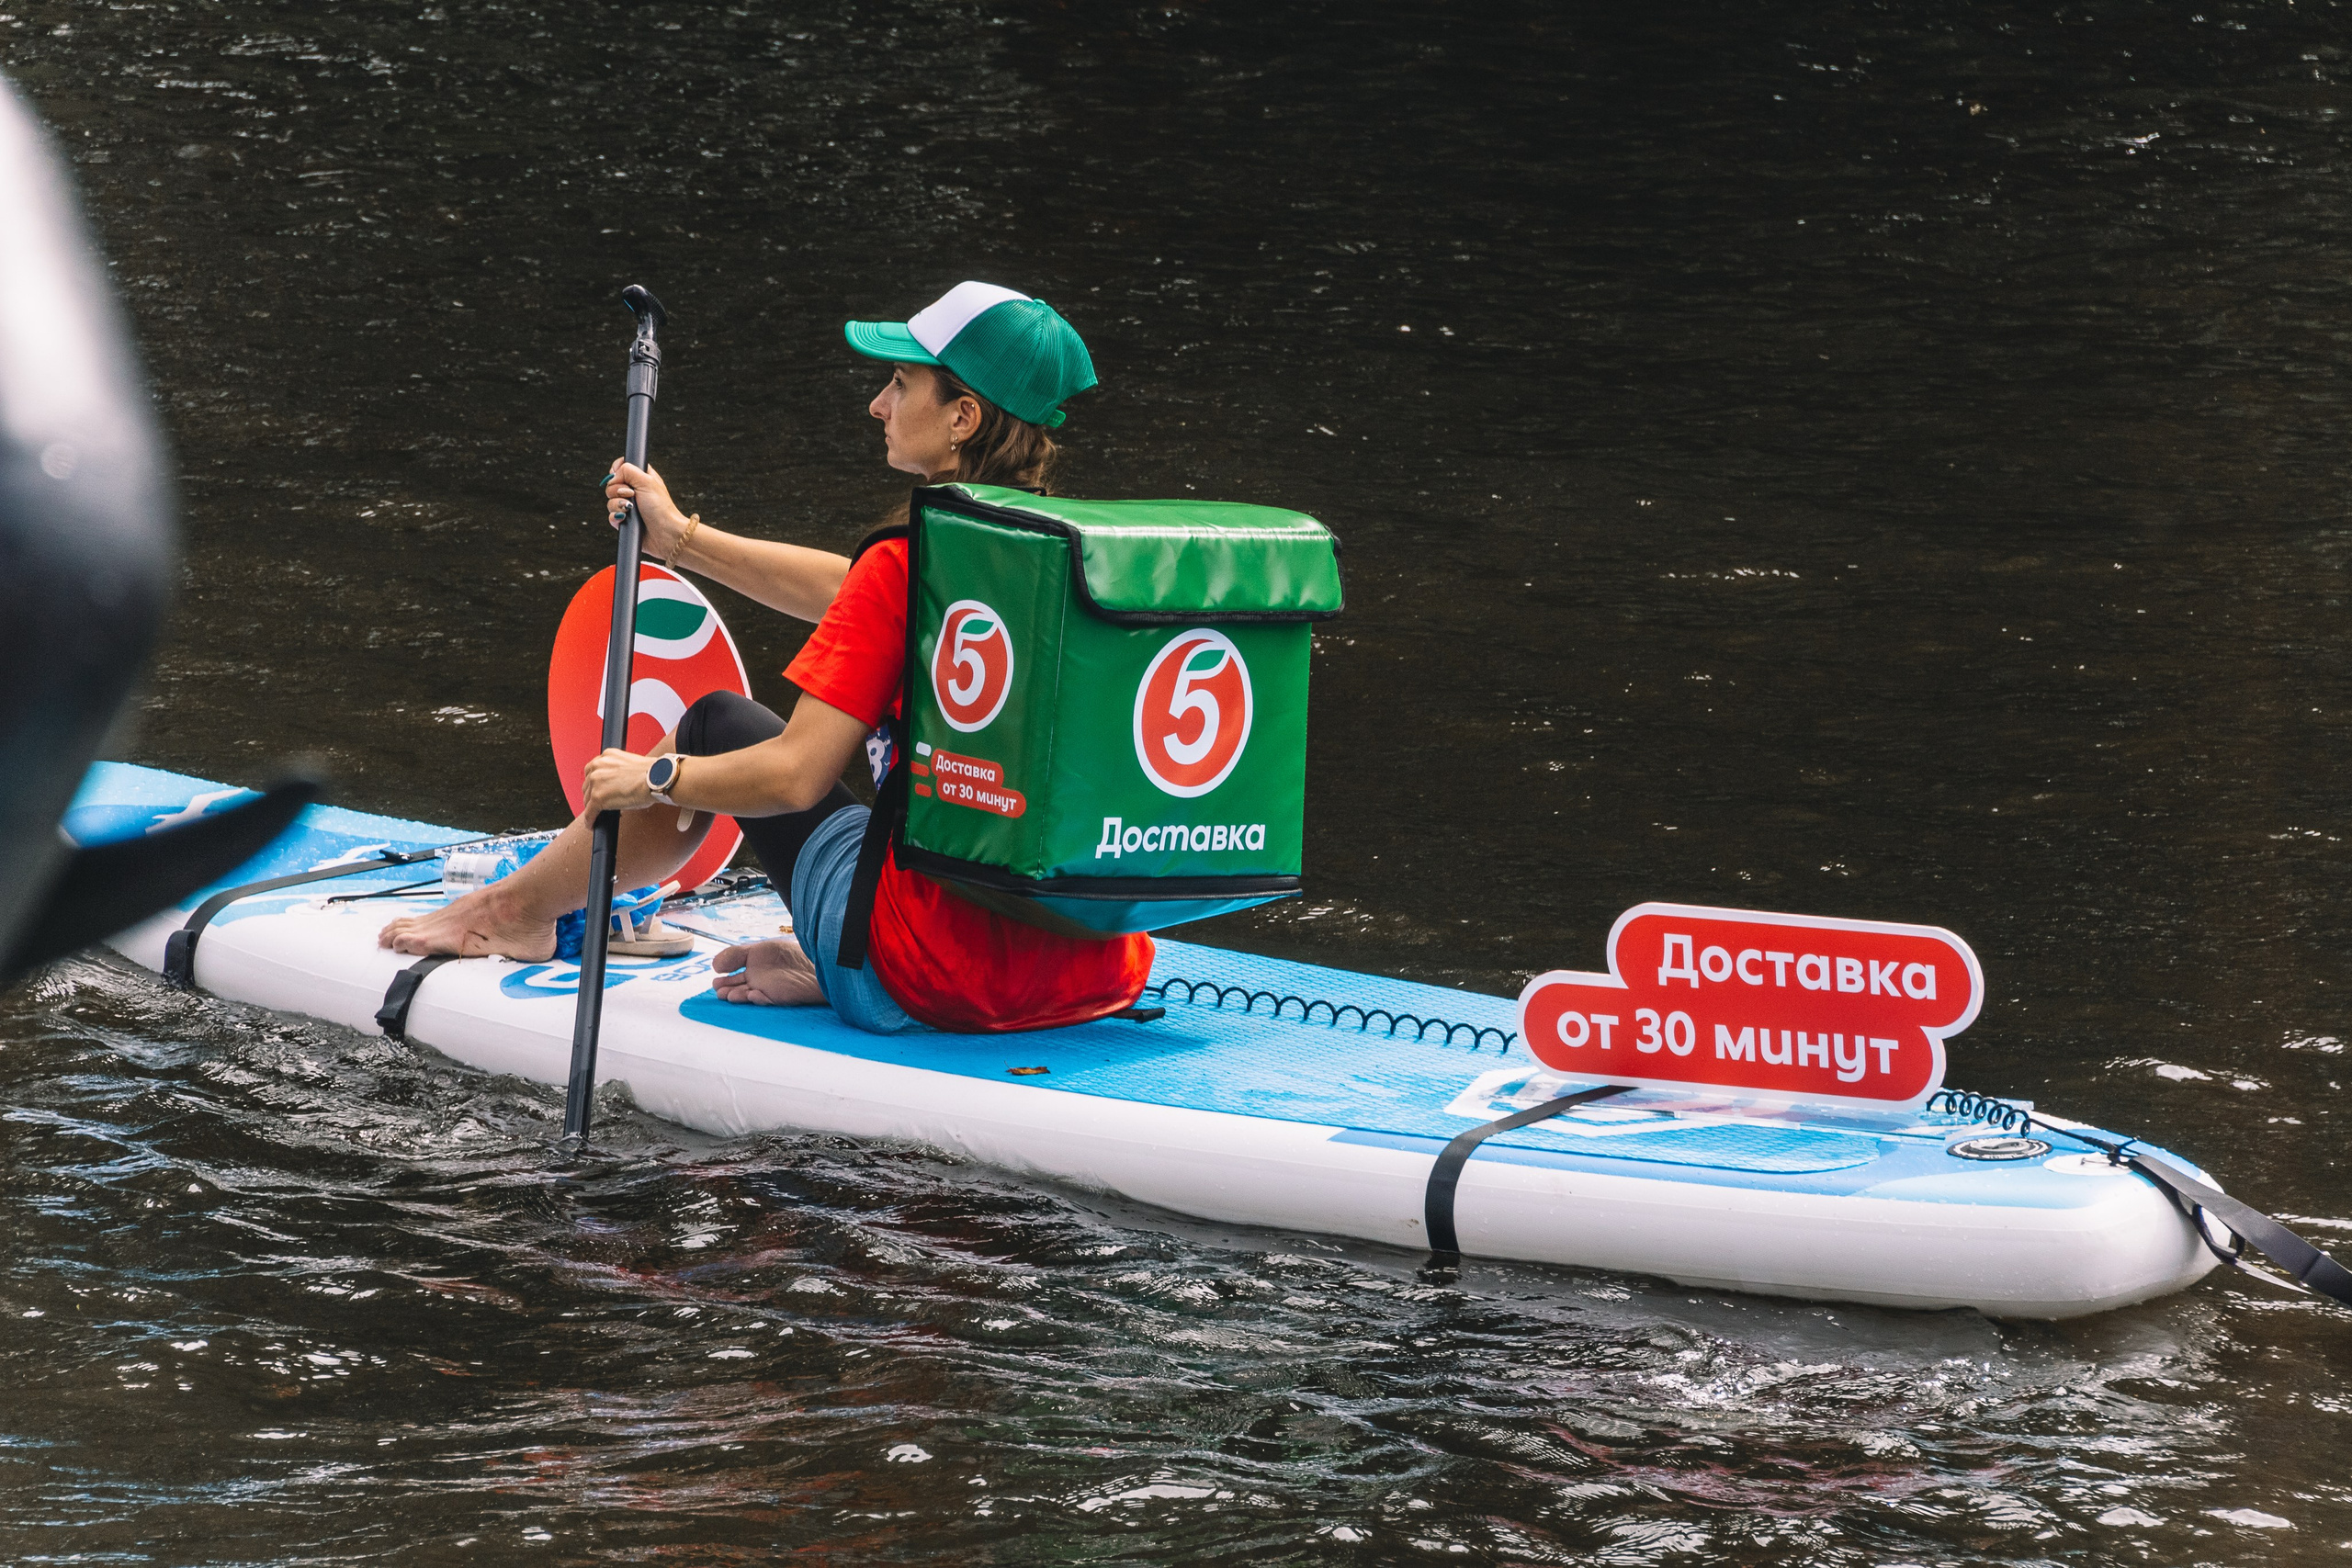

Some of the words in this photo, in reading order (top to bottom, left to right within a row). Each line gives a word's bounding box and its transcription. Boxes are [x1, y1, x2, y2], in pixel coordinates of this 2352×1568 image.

[948, 613, 996, 706] 5
[1163, 641, 1231, 765] 5
[935, 754, 996, 783] Доставка
[943, 782, 957, 796] от
[959, 784, 974, 800] 30
[976, 790, 1017, 813] минут
[1095, 817, 1266, 859] Доставка
[1658, 933, 1937, 1000] Доставка
[1557, 1011, 1620, 1050] от
[1636, 1009, 1696, 1056] 30
[1715, 1024, 1899, 1083] минут
